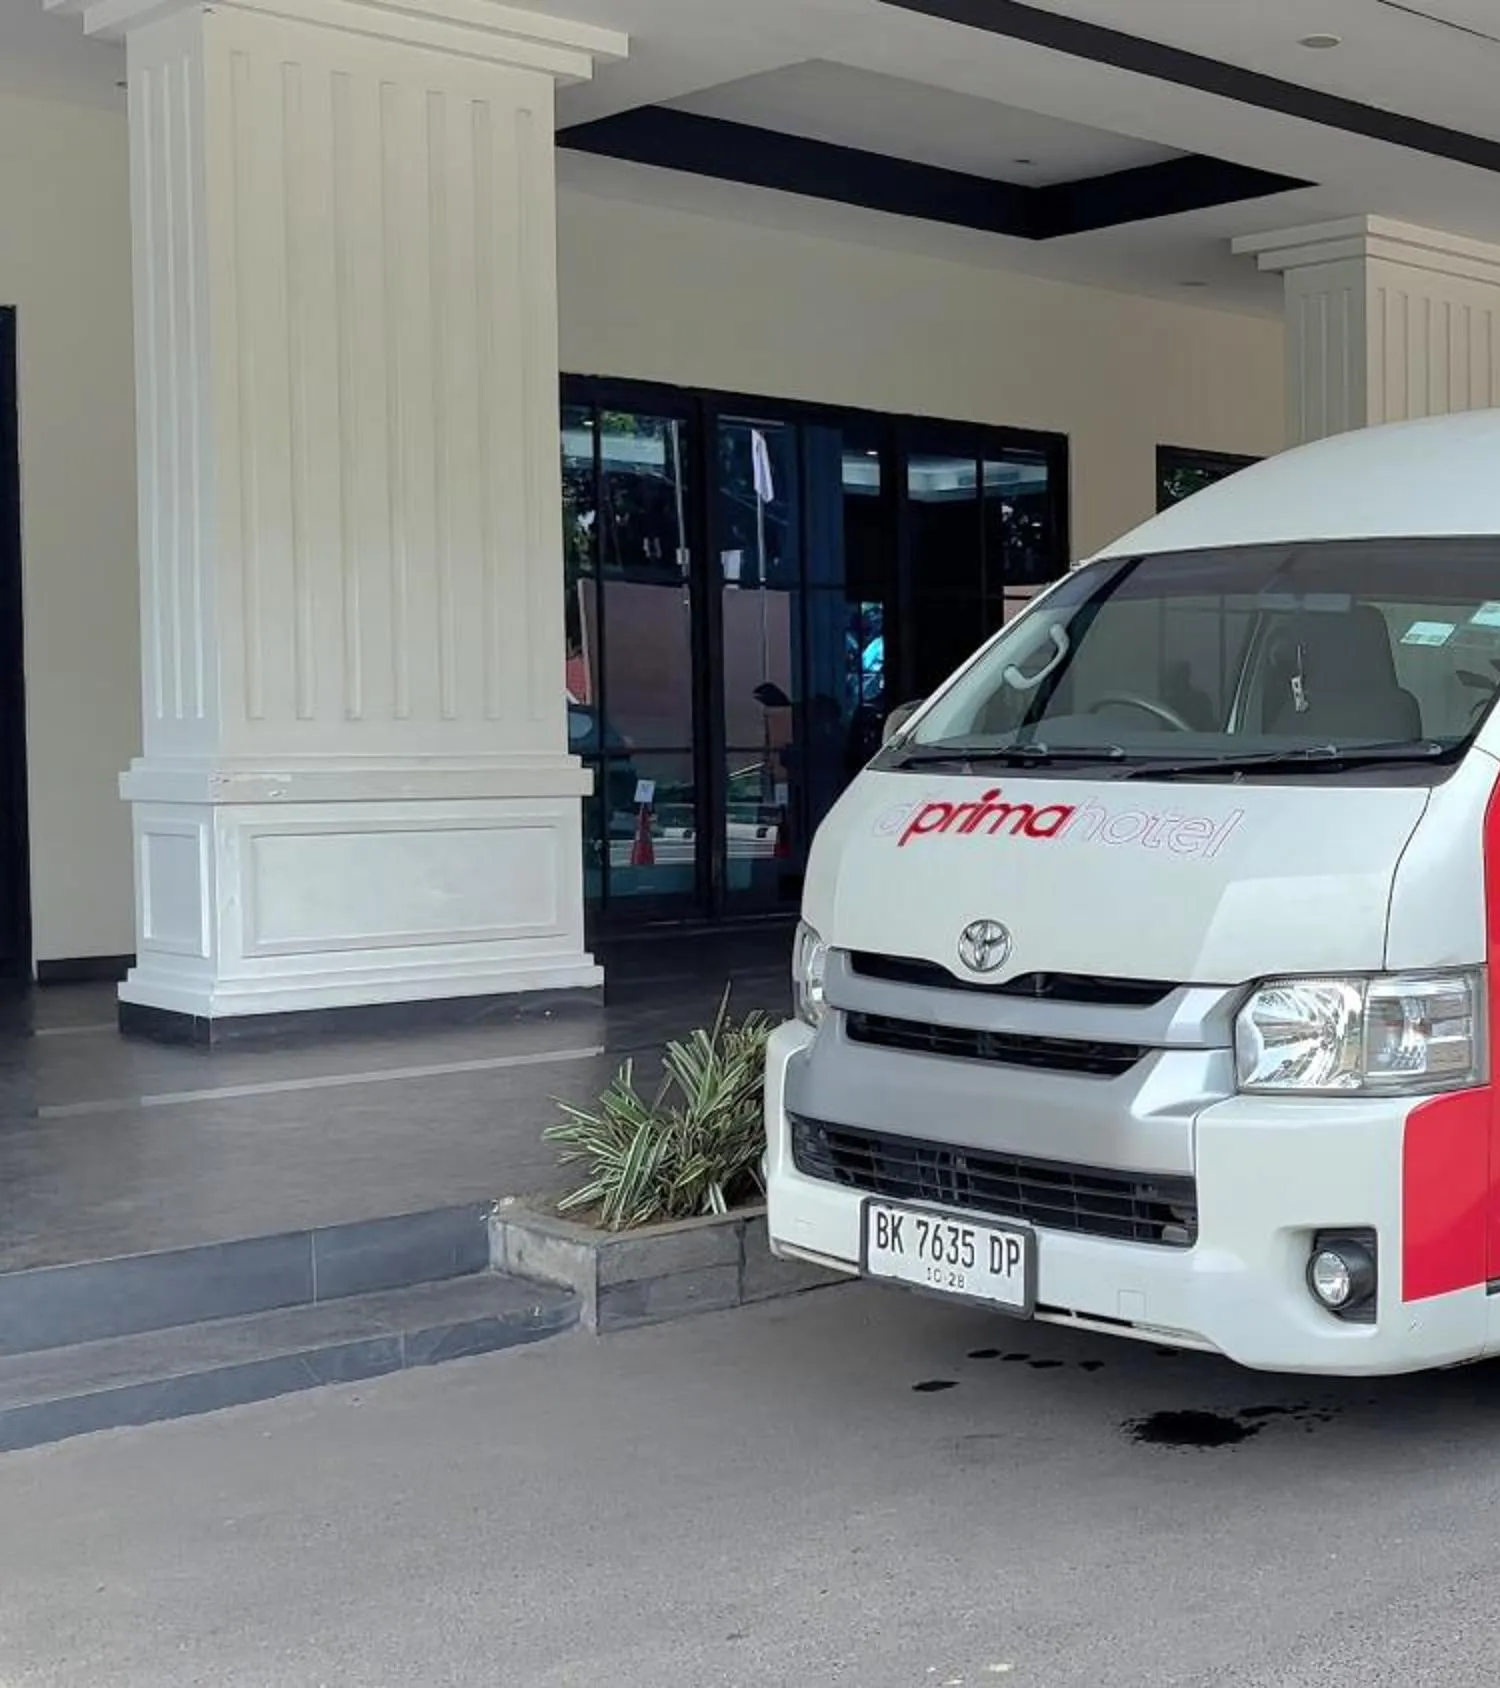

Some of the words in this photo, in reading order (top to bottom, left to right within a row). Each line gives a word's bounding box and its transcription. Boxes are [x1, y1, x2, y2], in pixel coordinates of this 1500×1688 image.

[876, 1211, 904, 1254] BK
[916, 1219, 975, 1269] 7635
[990, 1235, 1021, 1278] DP
